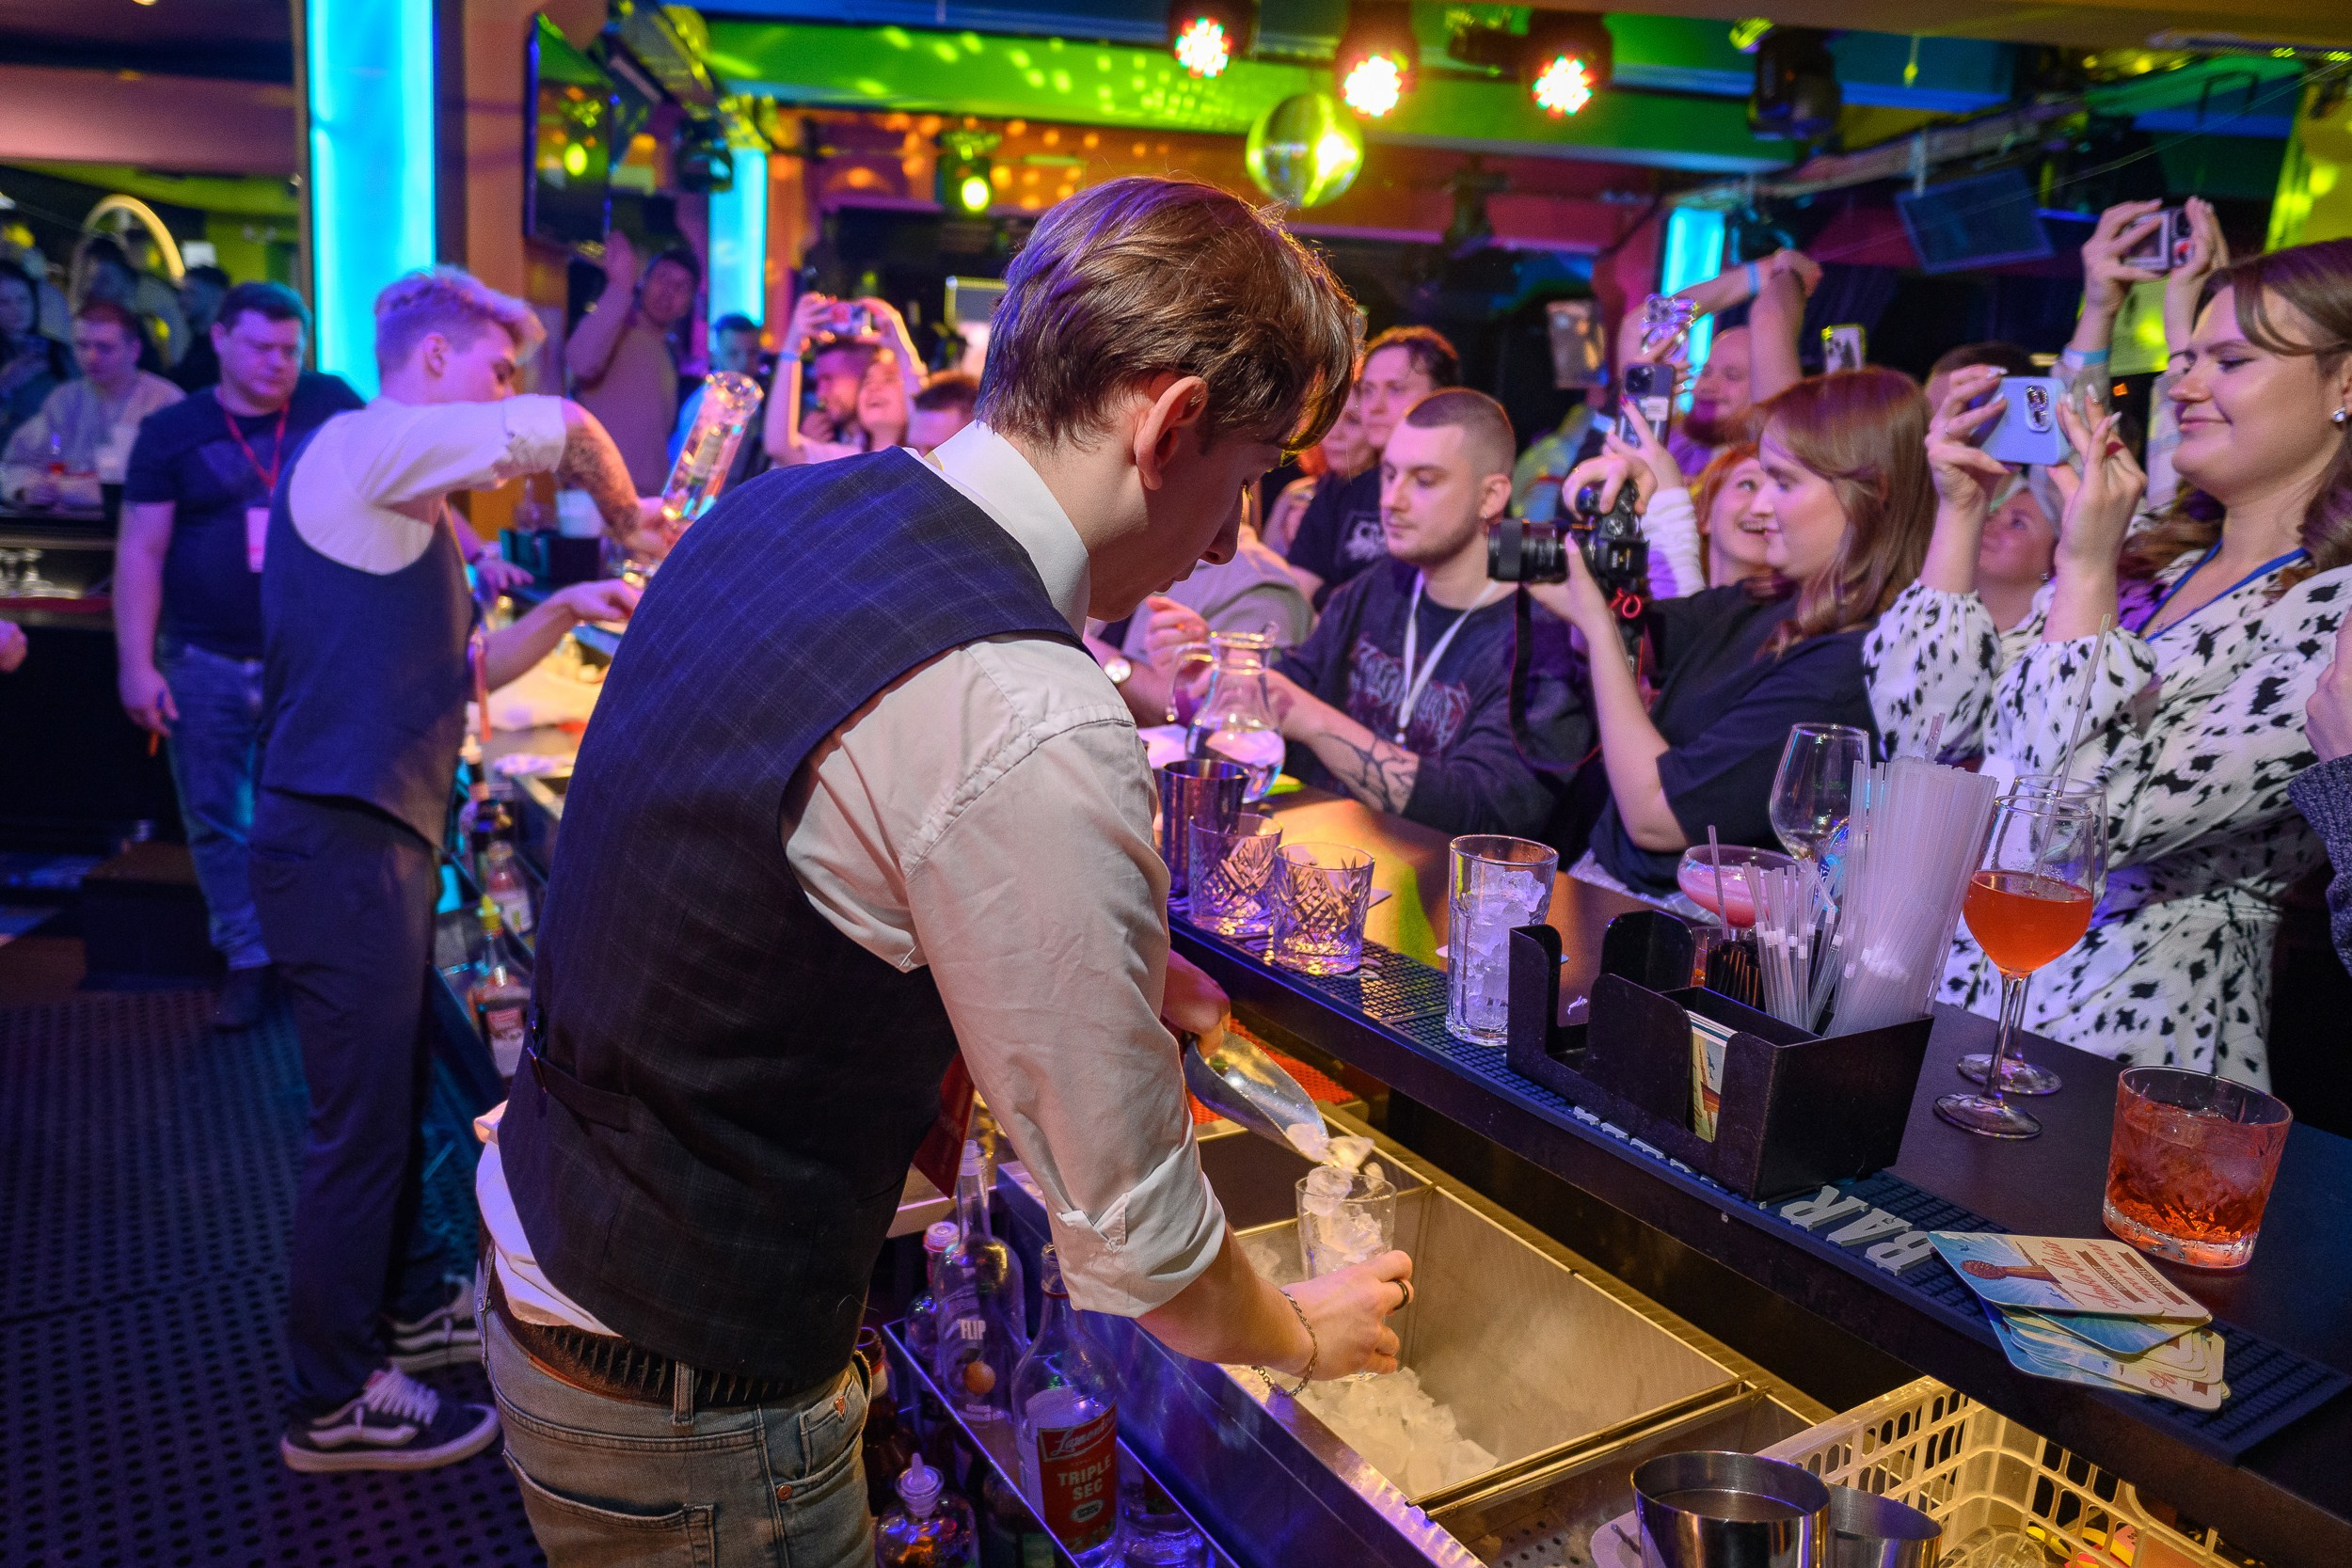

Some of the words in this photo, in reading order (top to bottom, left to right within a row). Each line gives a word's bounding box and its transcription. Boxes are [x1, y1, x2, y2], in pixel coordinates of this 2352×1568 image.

[2091, 1264, 2126, 1292] DRAUGHT
[2136, 1266, 2170, 1292] DRAUGHT
[1057, 1455, 1112, 1487] TRIPLE
[1073, 1478, 1103, 1501] SEC
